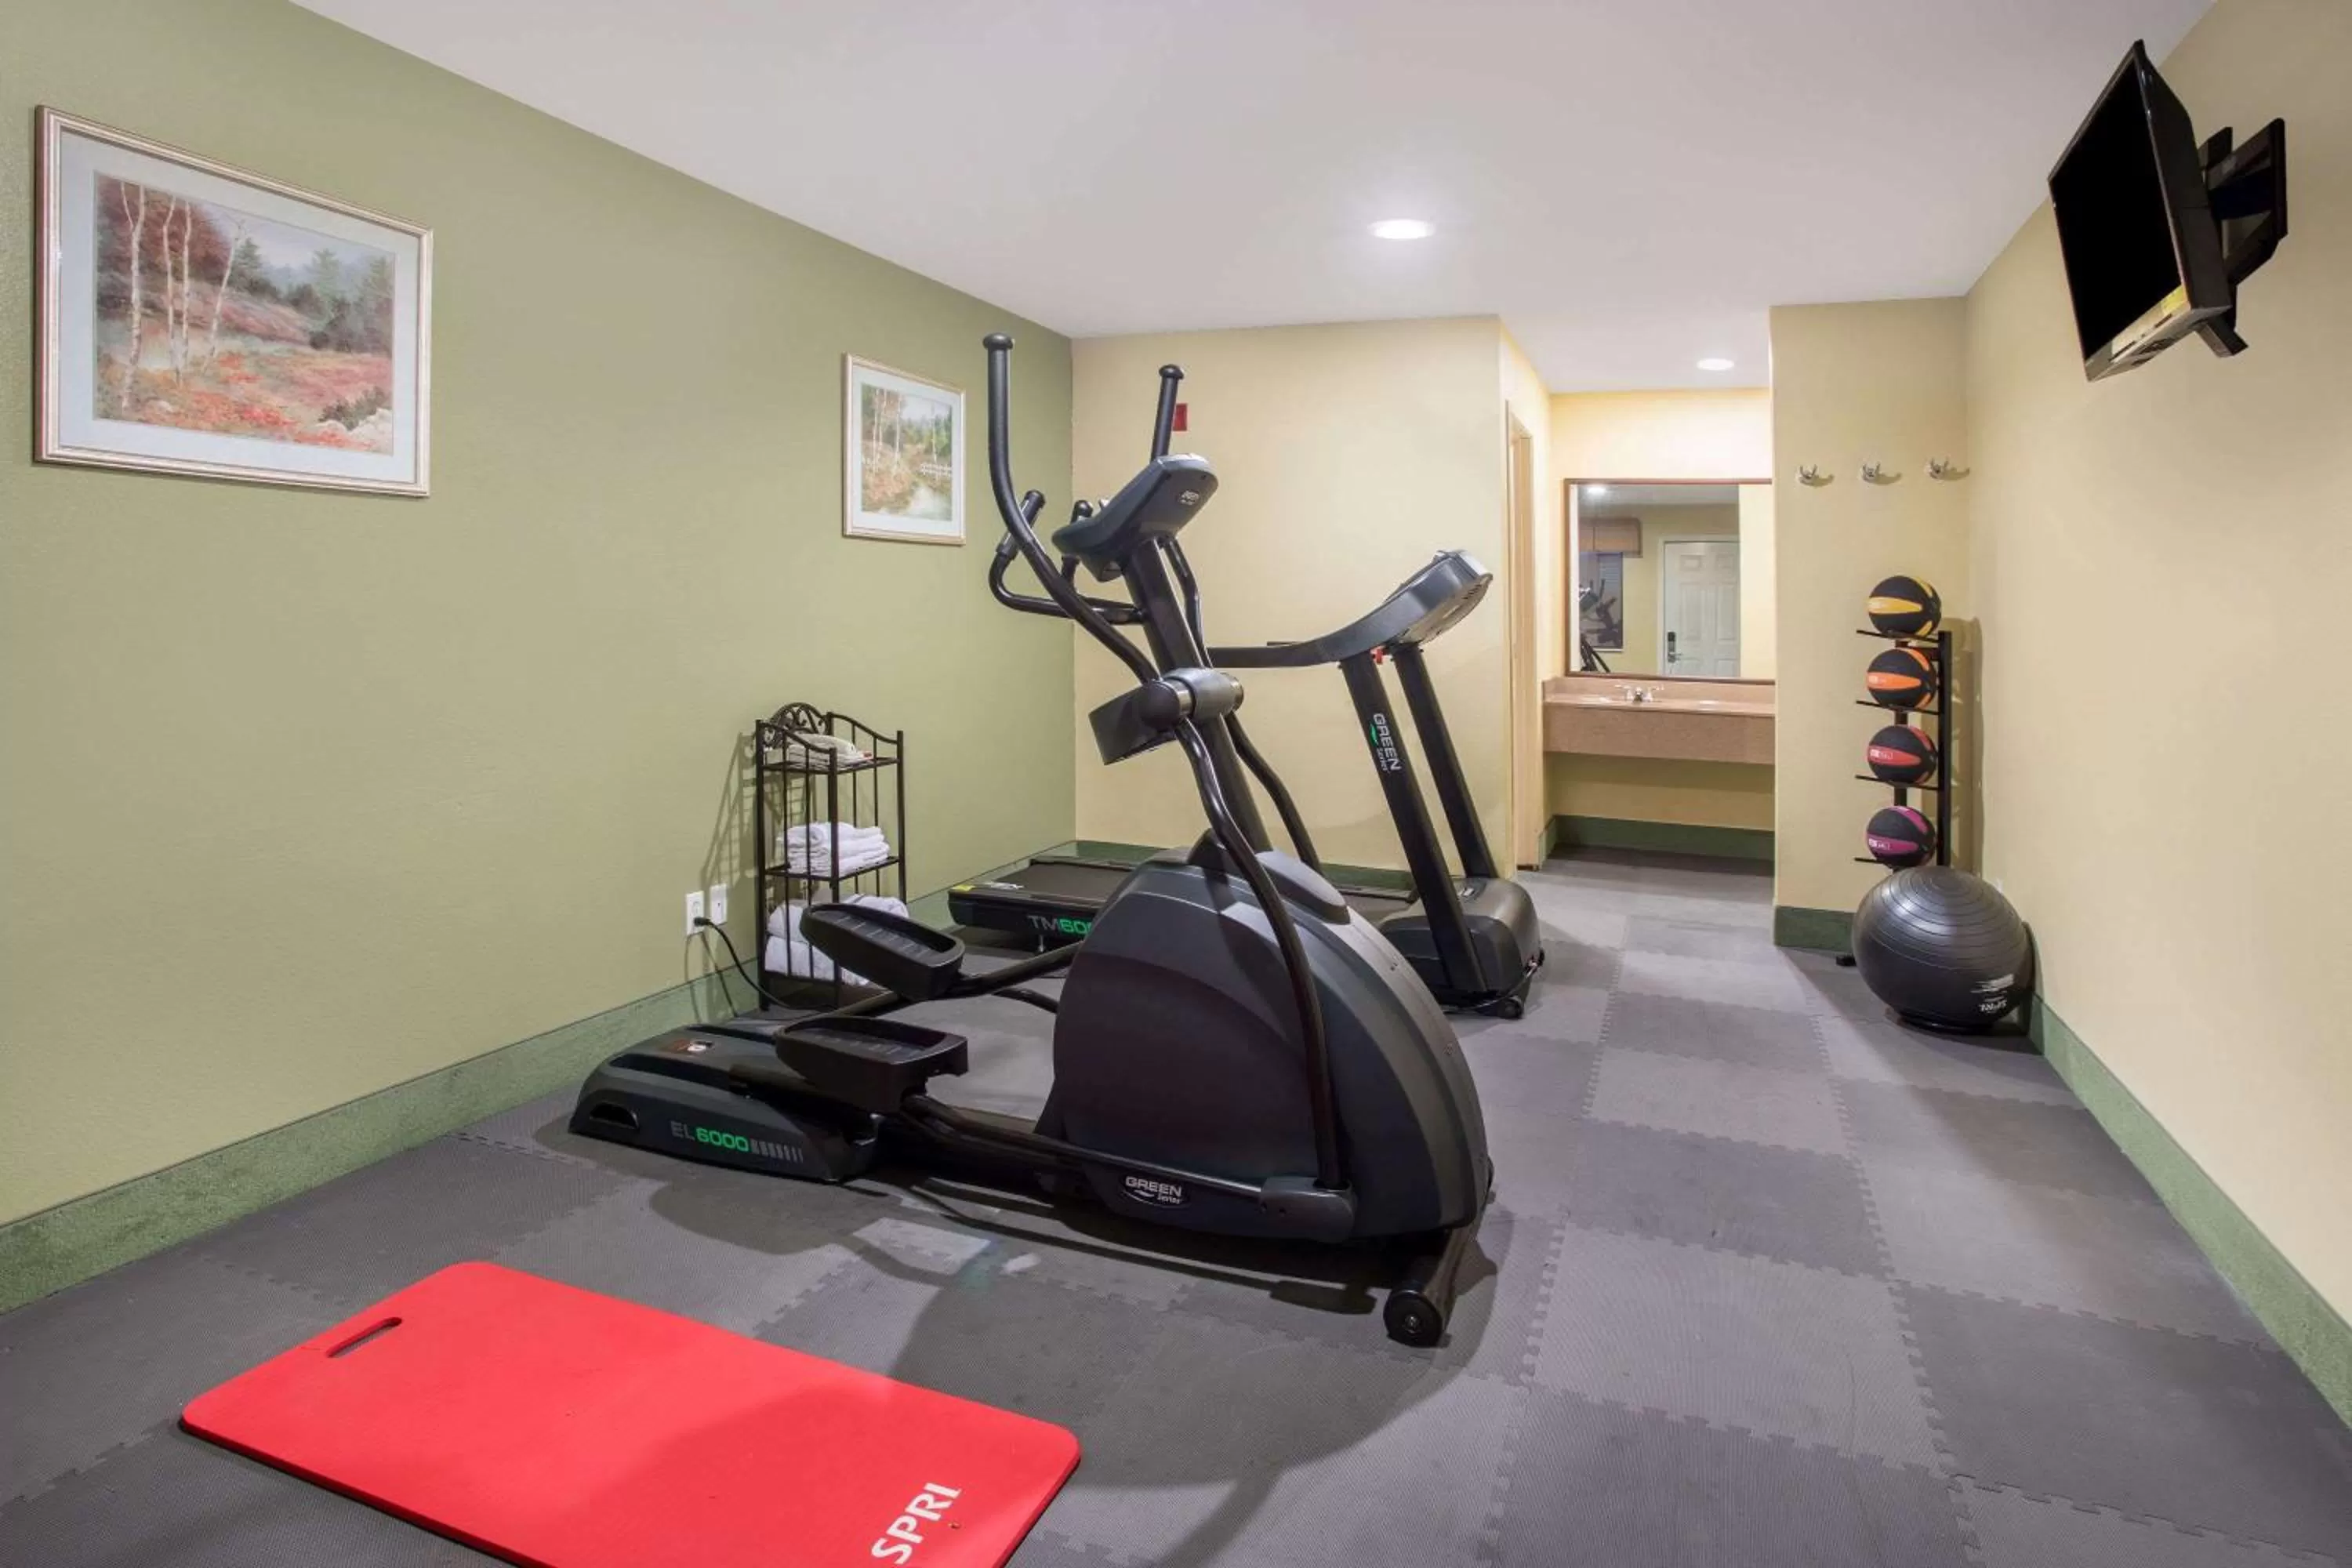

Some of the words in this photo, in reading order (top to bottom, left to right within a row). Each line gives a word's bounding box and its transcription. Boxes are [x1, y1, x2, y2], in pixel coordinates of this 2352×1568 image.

[1373, 713, 1402, 771] GREEN
[1027, 914, 1093, 935] TM60
[1125, 1176, 1182, 1198] GREEN
[871, 1482, 962, 1565] SPRI
